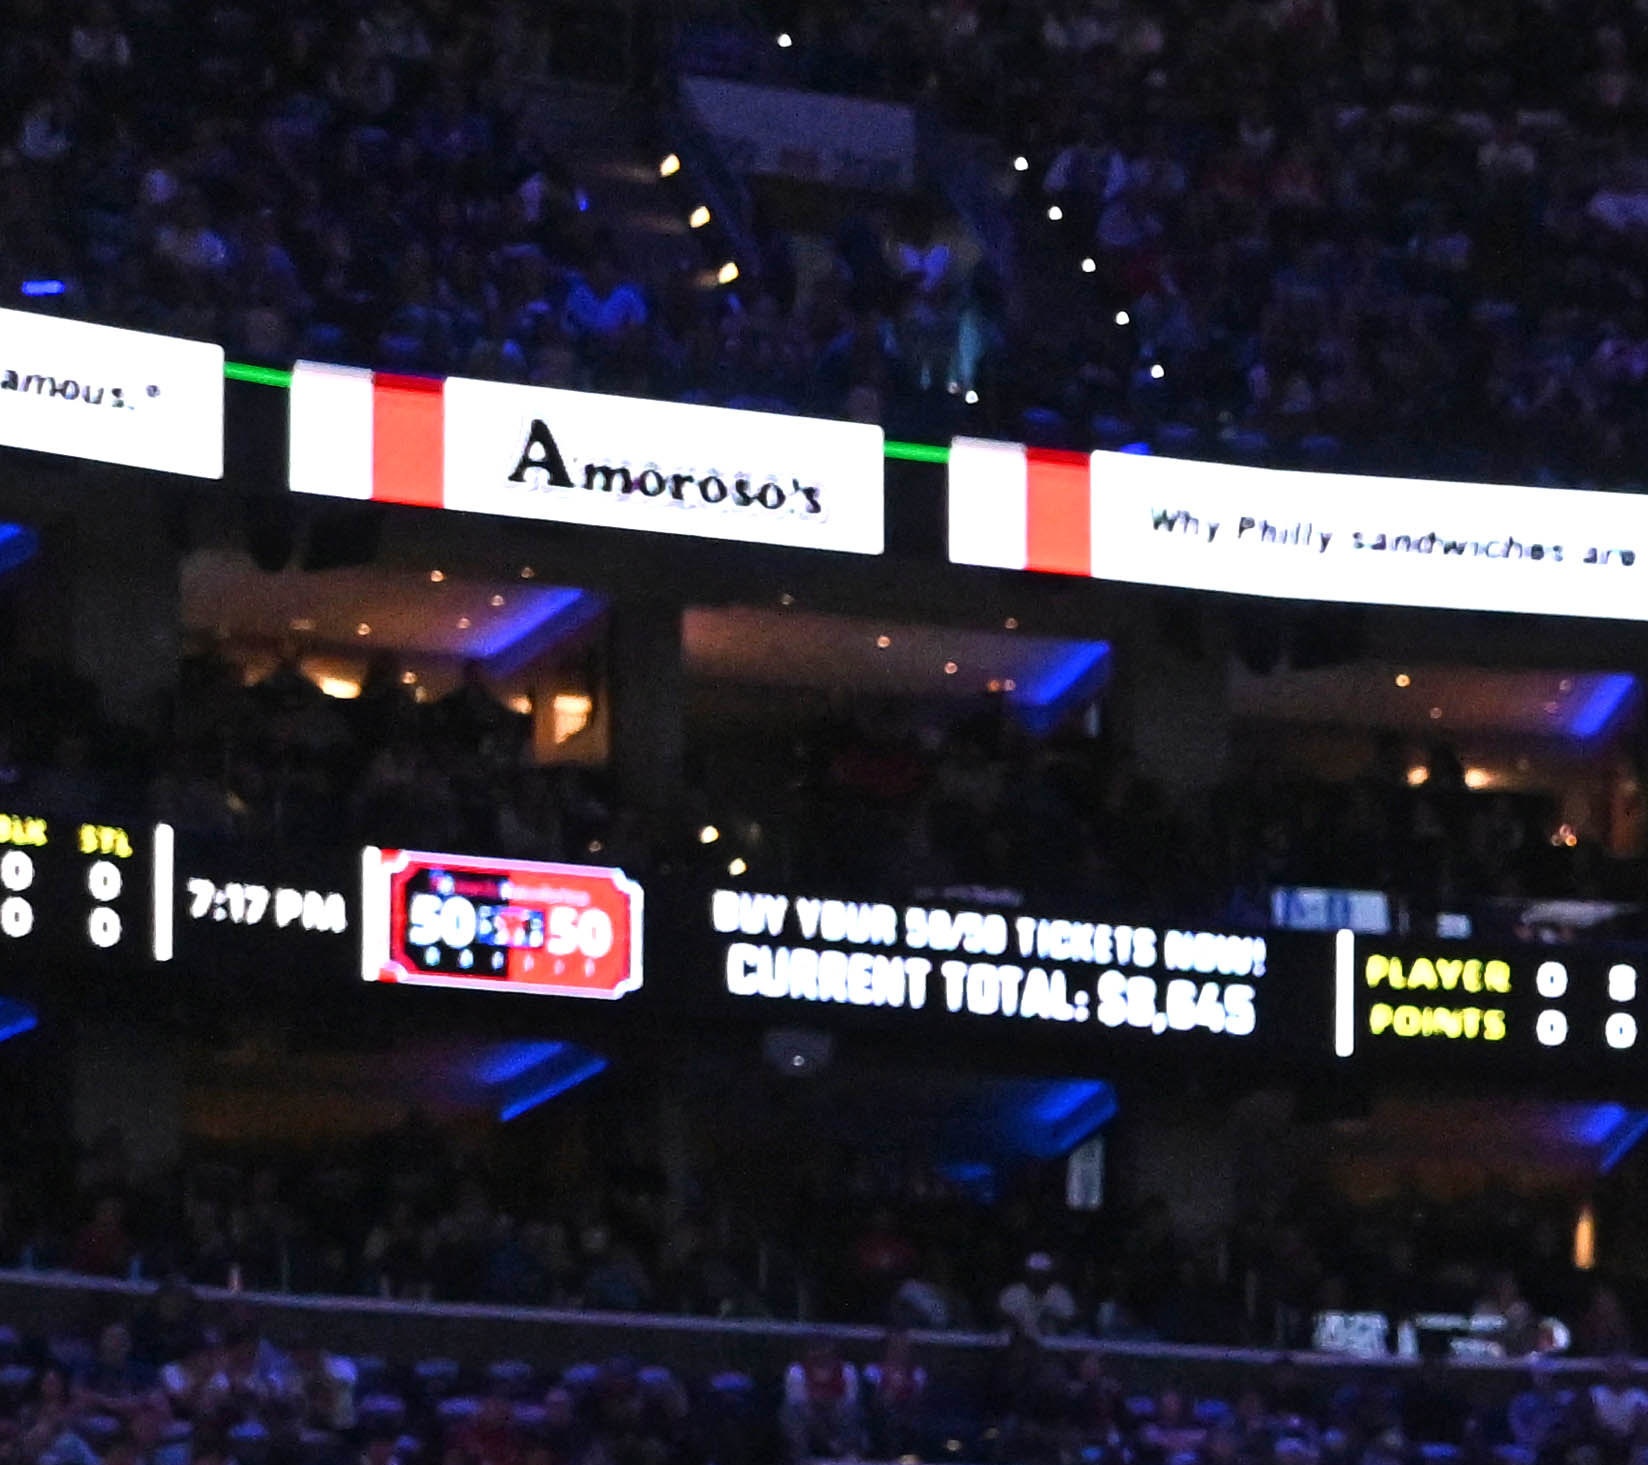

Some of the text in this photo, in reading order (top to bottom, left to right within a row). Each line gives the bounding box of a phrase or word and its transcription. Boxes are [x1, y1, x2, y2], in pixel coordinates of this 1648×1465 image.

[508, 418, 823, 515] Amoroso's
[1, 850, 122, 902] 0 0
[0, 896, 122, 948] 0 0
[188, 878, 346, 933] 7:17 PM
[409, 893, 476, 948] 50
[547, 905, 613, 958] 50
[726, 943, 933, 1010] CURRENT
[941, 962, 1089, 1024] TOTAL:
[1366, 955, 1510, 992] PLAYER
[1537, 962, 1567, 997] 0
[1370, 1004, 1505, 1040] POINTS
[1536, 1010, 1567, 1045] 0
[1606, 1013, 1636, 1048] 0
